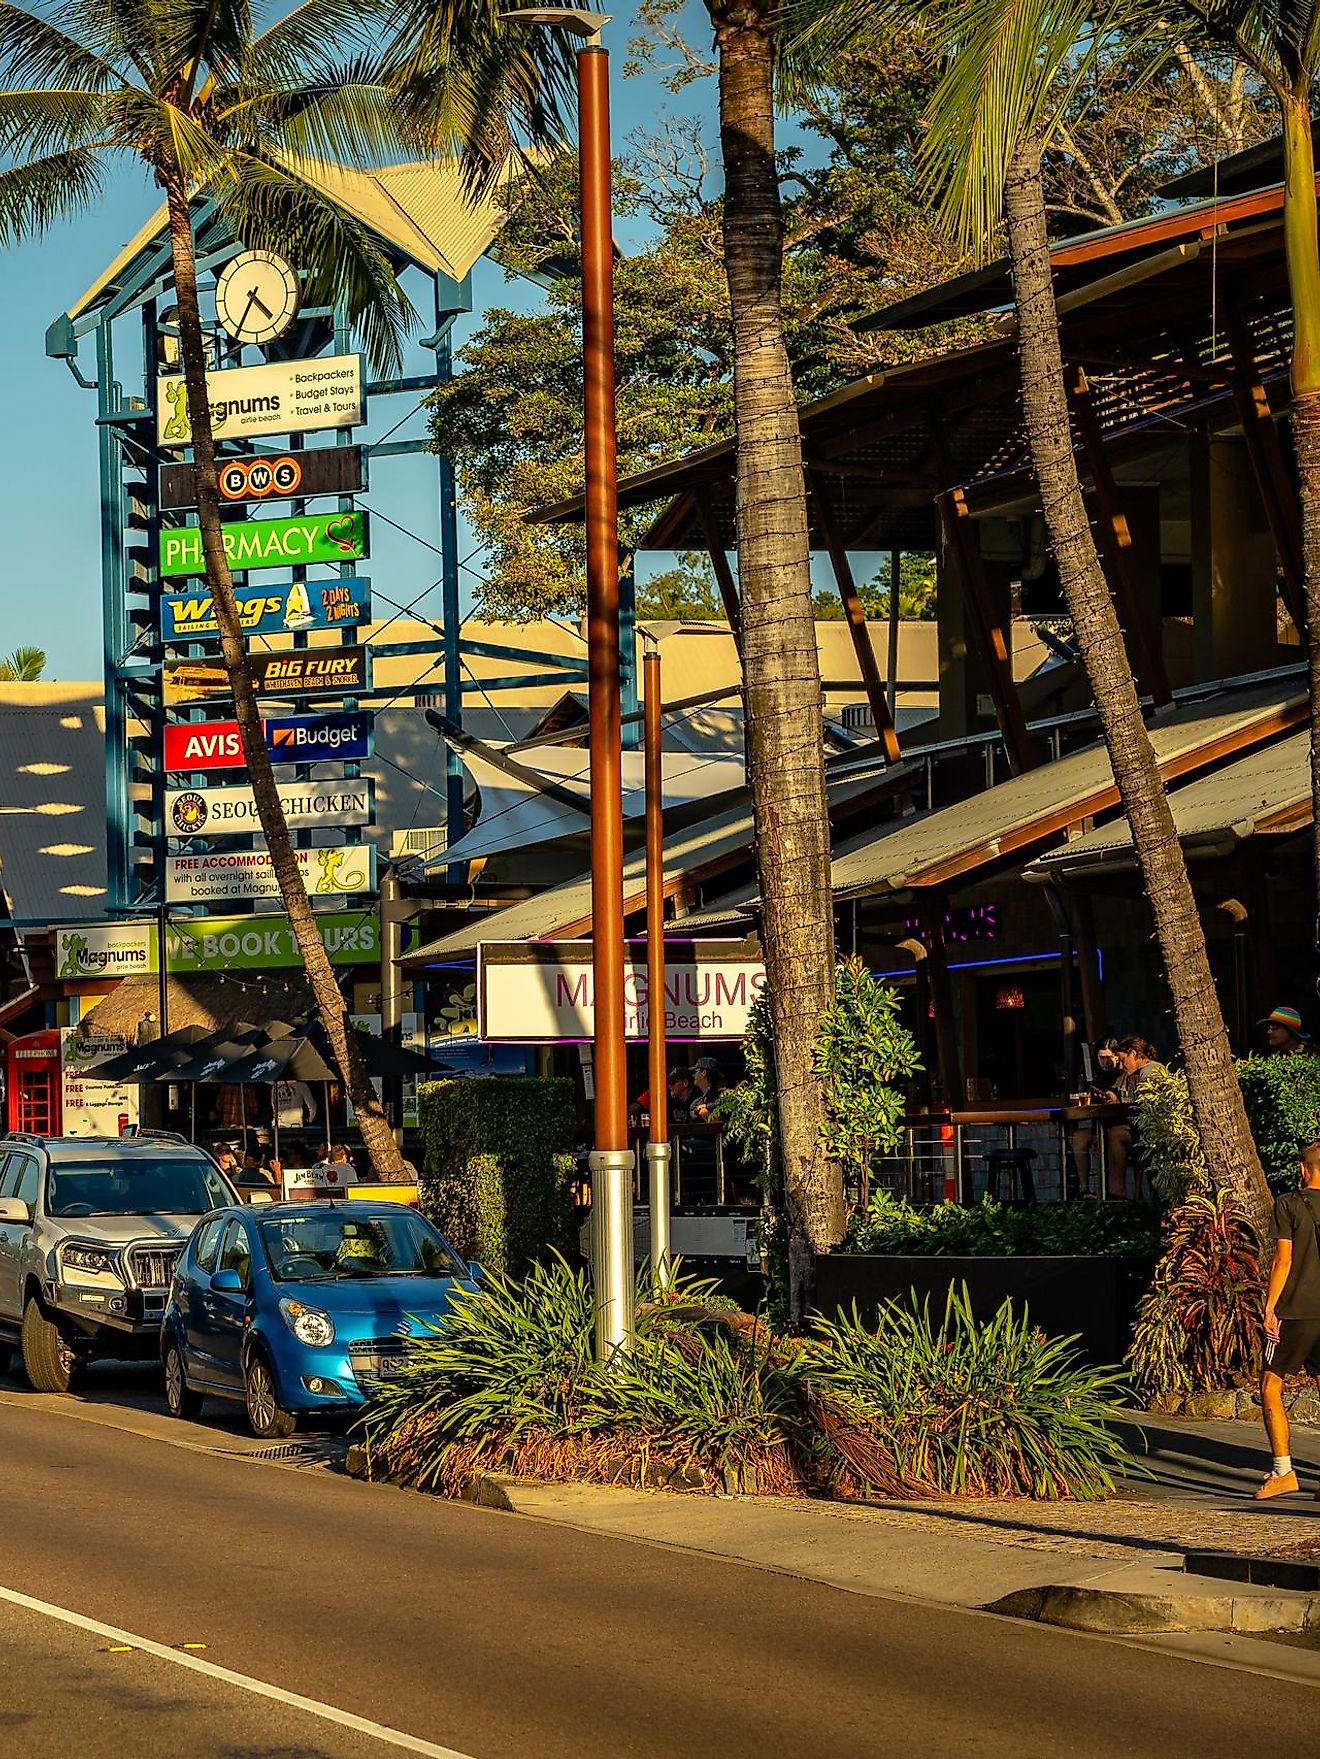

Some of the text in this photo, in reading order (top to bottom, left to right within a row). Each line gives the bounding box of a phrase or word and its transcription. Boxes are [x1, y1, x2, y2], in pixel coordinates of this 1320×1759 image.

[295, 369, 354, 384] Backpackers
[295, 385, 354, 400] Budget Stays
[204, 395, 280, 422] agnums
[295, 401, 356, 416] Travel & Tours
[259, 413, 281, 423] beach
[230, 469, 291, 488] BWS
[166, 526, 319, 567] PHRMACY
[321, 586, 350, 605] 2 DAYS
[326, 605, 333, 621] 2
[305, 657, 359, 676] FURY
[304, 675, 324, 687] BEACH
[296, 725, 358, 748] Budget
[184, 733, 240, 759] AVIS
[211, 800, 259, 820] SEOU
[175, 859, 199, 870] FREE
[173, 873, 192, 884] with
[194, 872, 206, 883] all
[208, 870, 254, 883] overnight
[191, 884, 229, 896] booked
[231, 884, 242, 894] at
[202, 931, 282, 959] BOOK
[286, 925, 374, 956] TURS
[76, 948, 146, 967] Magnums
[557, 972, 768, 1007] MGNUMS
[665, 1011, 723, 1029] Beach
[65, 1084, 84, 1093] FREE
[65, 1099, 84, 1108] FREE
